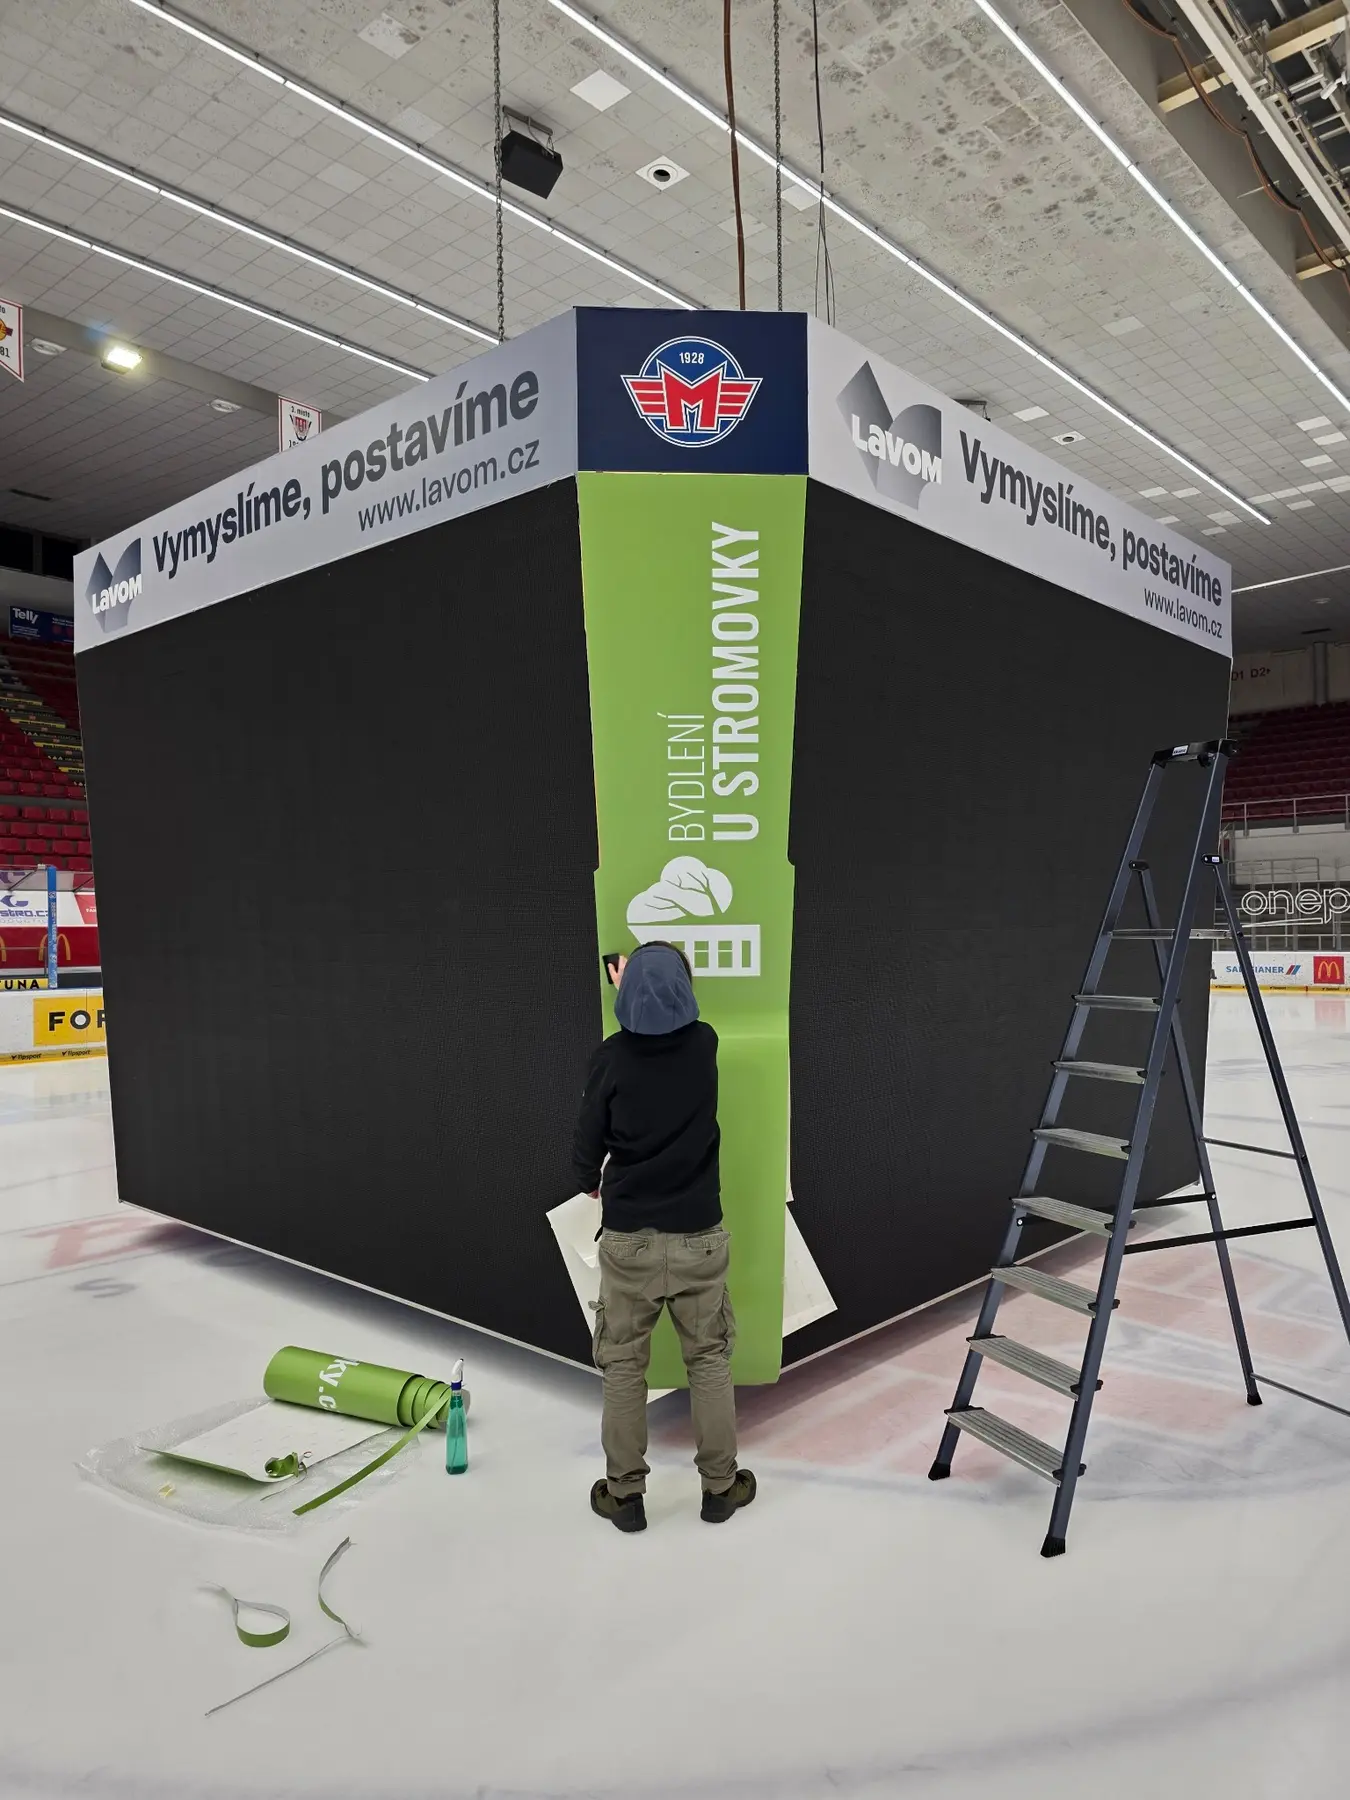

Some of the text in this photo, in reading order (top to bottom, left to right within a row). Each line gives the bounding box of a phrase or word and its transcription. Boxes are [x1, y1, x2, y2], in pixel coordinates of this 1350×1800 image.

[679, 352, 705, 365] 1928
[153, 370, 540, 580] Vymyslíme, postavíme
[358, 439, 541, 532] www.lavom.cz
[959, 429, 1223, 607] Vymyslíme, postavíme
[12, 607, 39, 625] Telly
[1143, 588, 1223, 640] www.lavom.cz
[711, 521, 760, 841] U STROMOVKY
[1251, 666, 1266, 679] D2
[656, 712, 706, 841] BYDLENÍ
[0, 979, 39, 990] UNA
